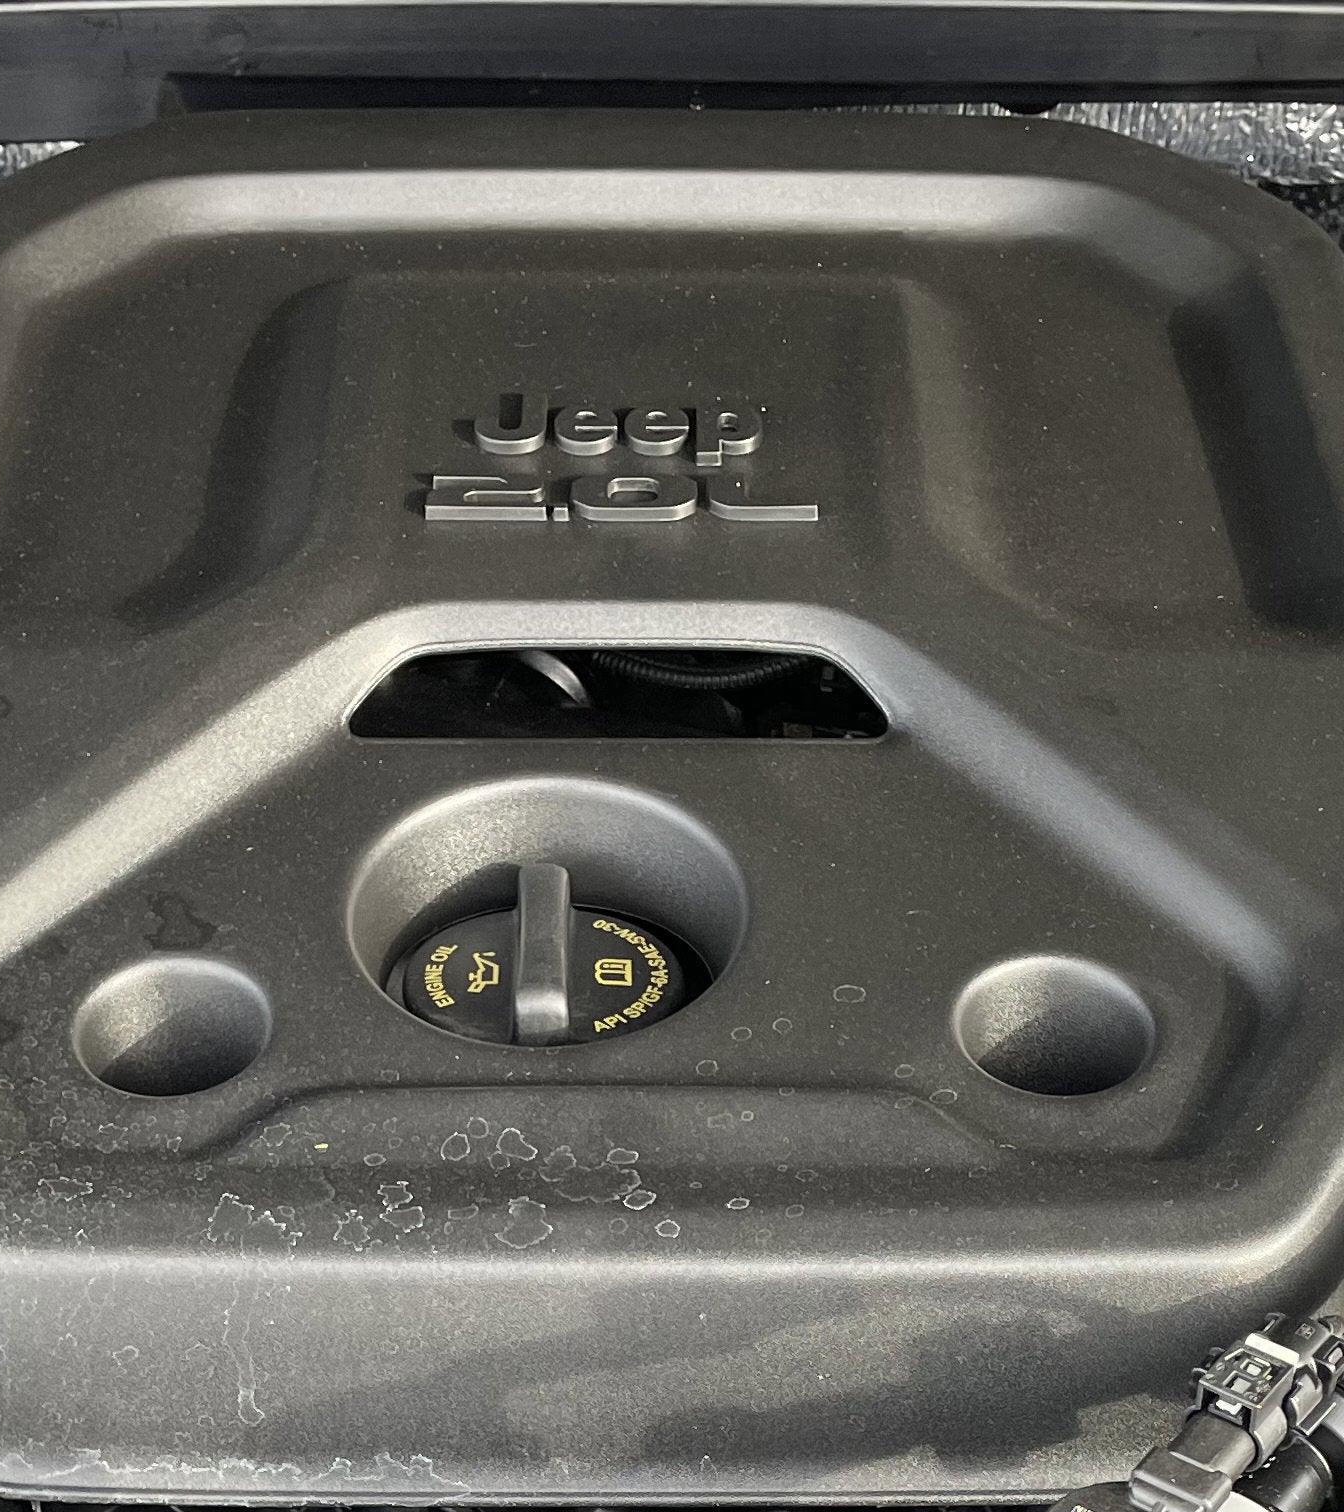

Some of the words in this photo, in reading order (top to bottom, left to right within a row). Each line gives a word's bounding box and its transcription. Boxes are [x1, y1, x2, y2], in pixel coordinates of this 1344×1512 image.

[474, 394, 763, 467] Jeep
[424, 475, 818, 522] 2.0L
[430, 944, 459, 962] OIL
[424, 964, 456, 1008] ENGINE
[594, 1013, 629, 1033] API
